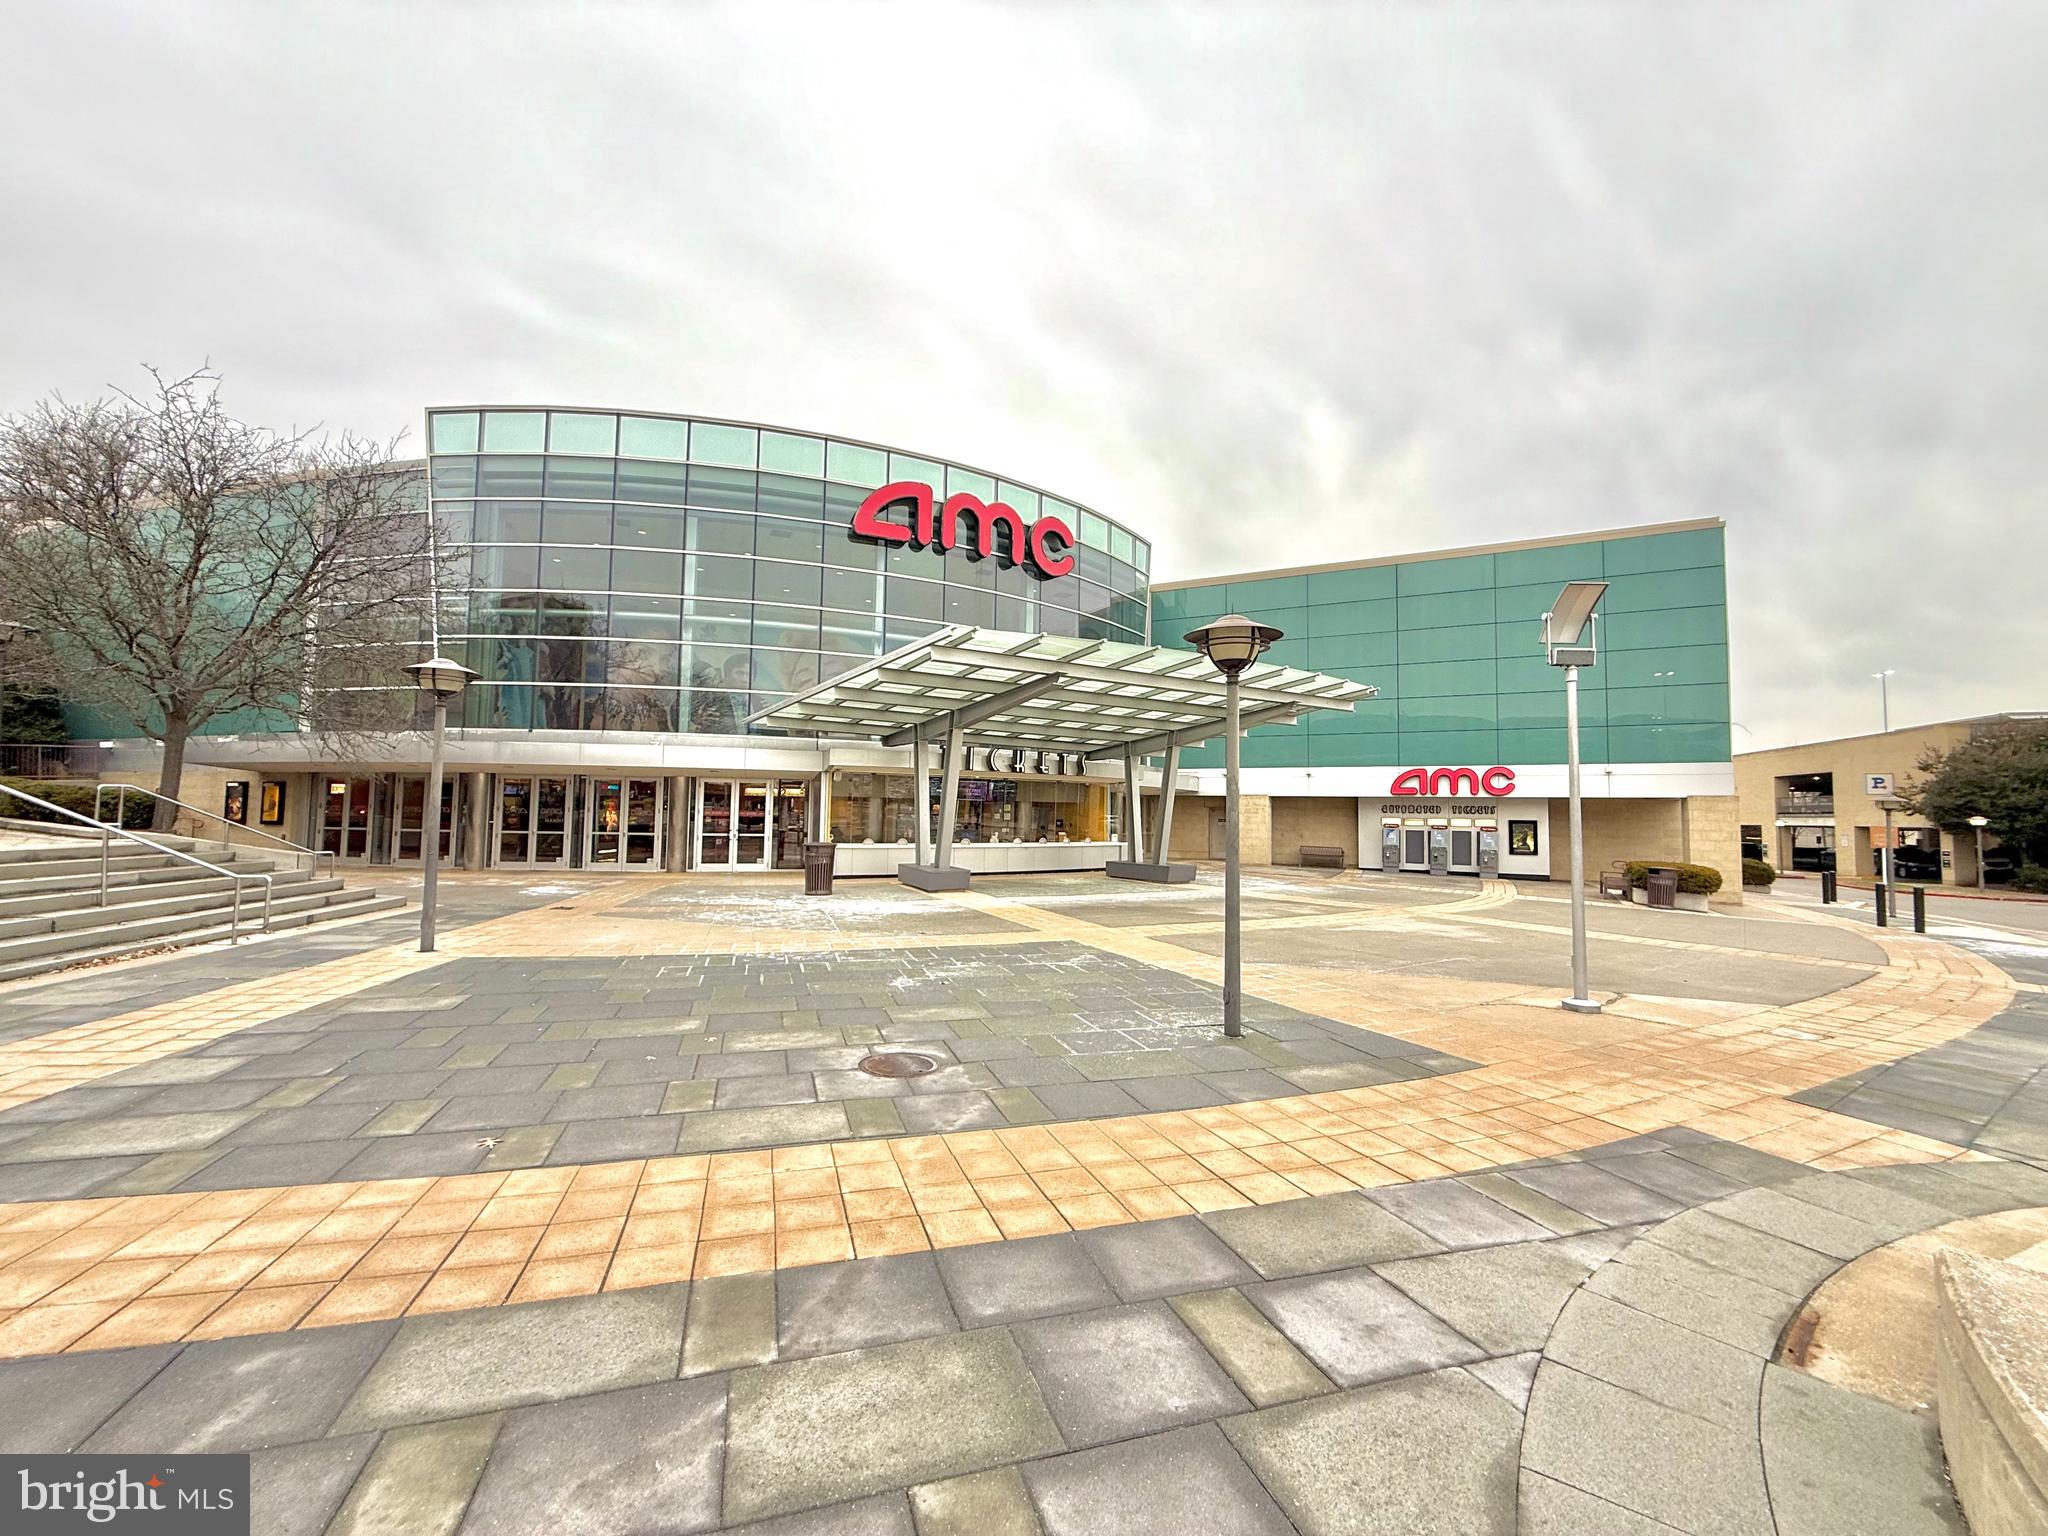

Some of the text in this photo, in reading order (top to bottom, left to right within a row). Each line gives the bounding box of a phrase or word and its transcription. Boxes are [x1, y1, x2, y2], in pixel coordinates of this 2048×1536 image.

[852, 481, 1076, 577] amc
[1390, 766, 1516, 797] amc
[1871, 777, 1886, 789] P
[1451, 805, 1497, 815] TICKETS
